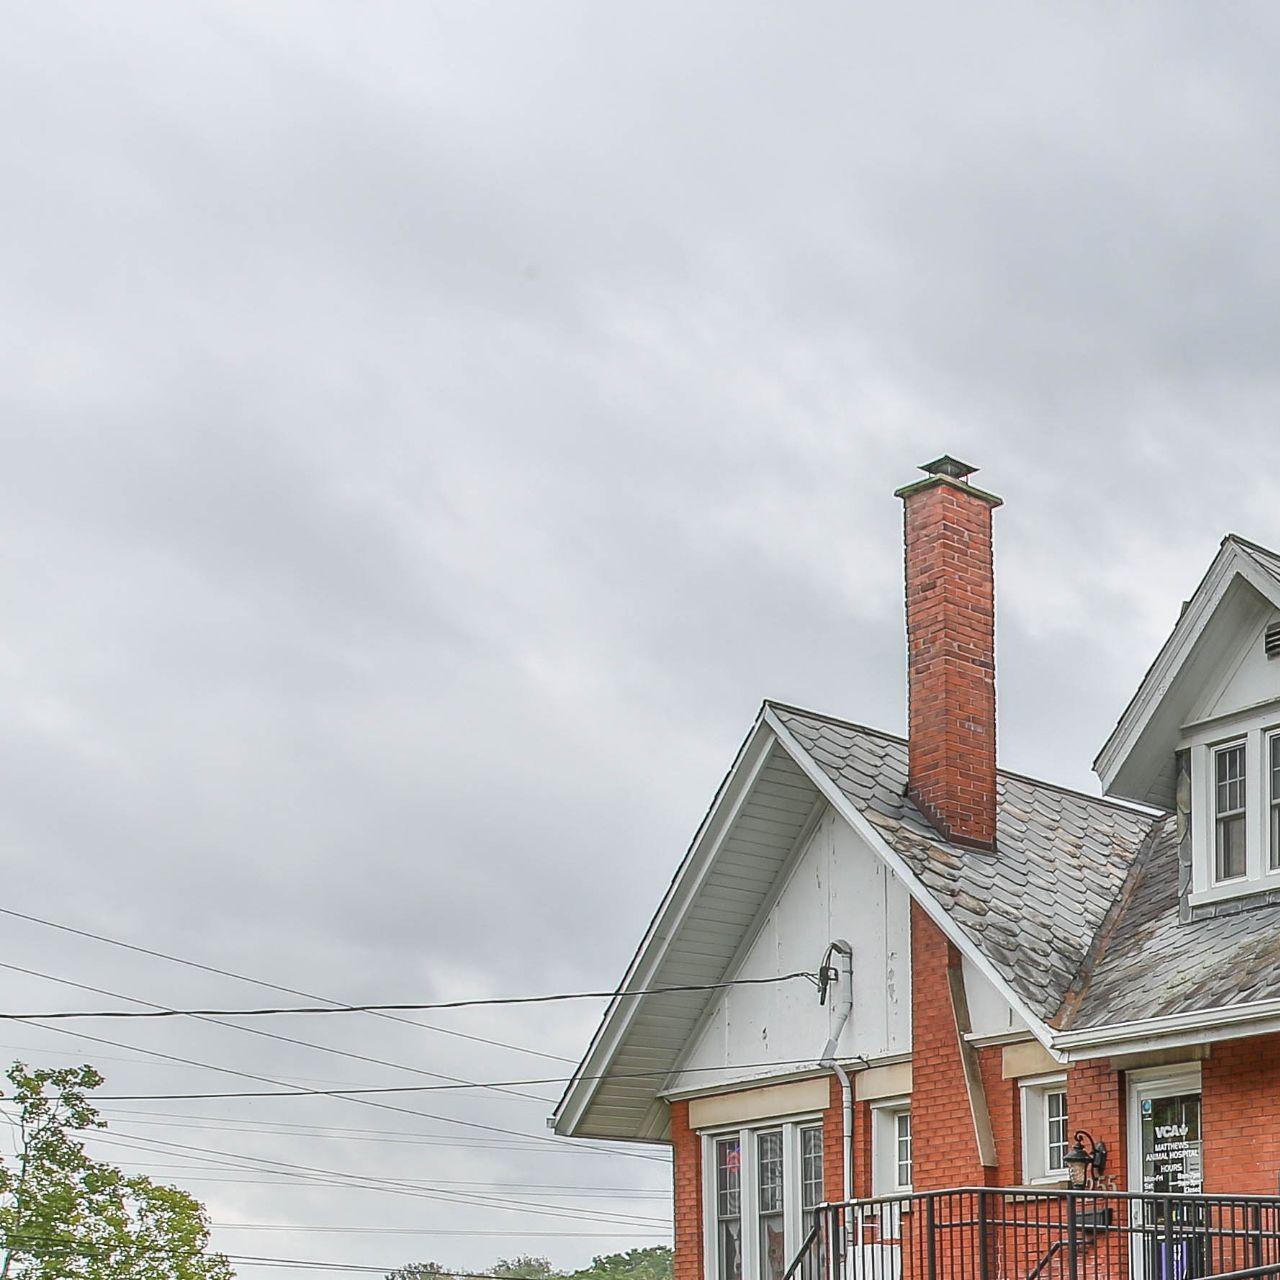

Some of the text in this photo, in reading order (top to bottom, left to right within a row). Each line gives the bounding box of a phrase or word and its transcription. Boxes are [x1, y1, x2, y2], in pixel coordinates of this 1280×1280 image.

[1155, 1124, 1180, 1138] VCA
[1155, 1141, 1189, 1151] MATTHEWS
[1145, 1149, 1199, 1161] ANIMAL HOSPITAL
